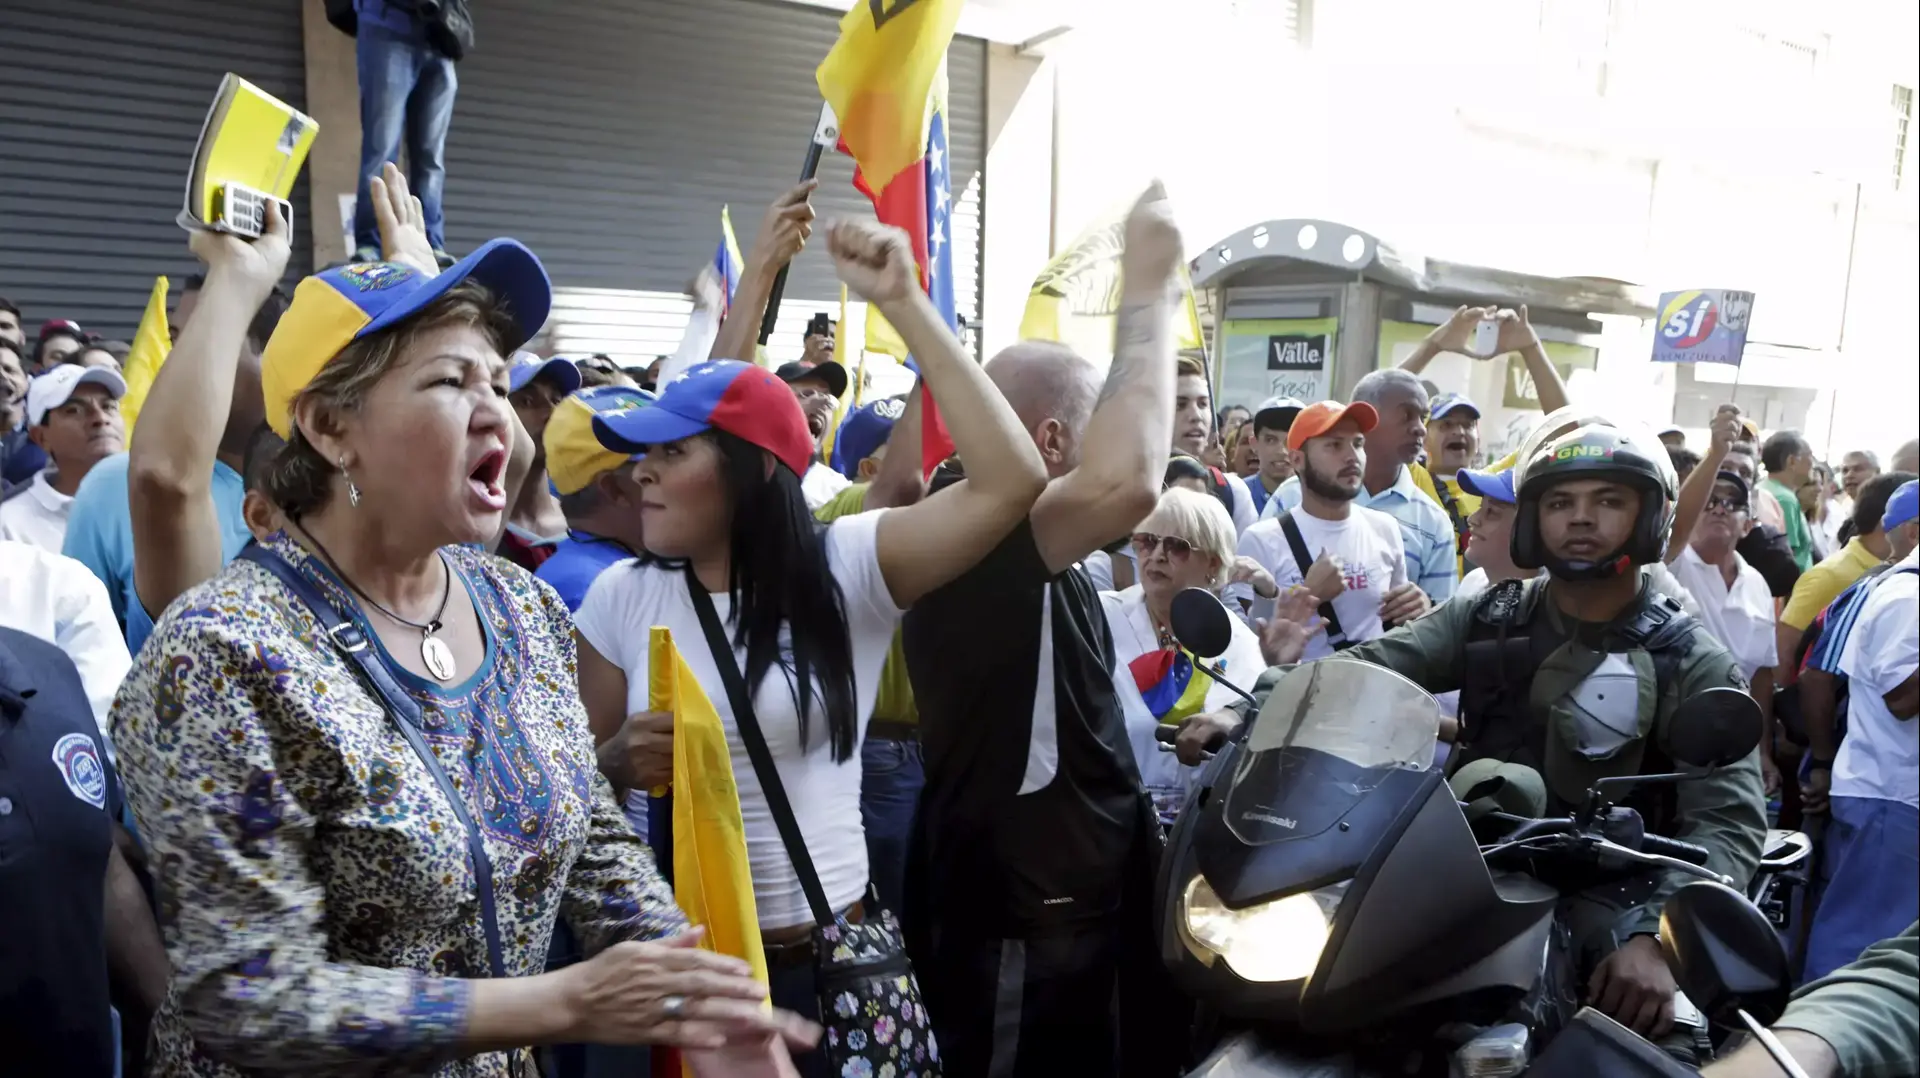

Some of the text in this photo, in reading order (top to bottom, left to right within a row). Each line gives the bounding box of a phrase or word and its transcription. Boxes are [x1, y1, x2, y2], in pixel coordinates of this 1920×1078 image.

[1271, 373, 1316, 398] Fresh
[1513, 366, 1540, 400] Va
[1557, 445, 1604, 460] GNB
[1343, 575, 1368, 591] RE
[1241, 810, 1297, 830] Kawasaki
